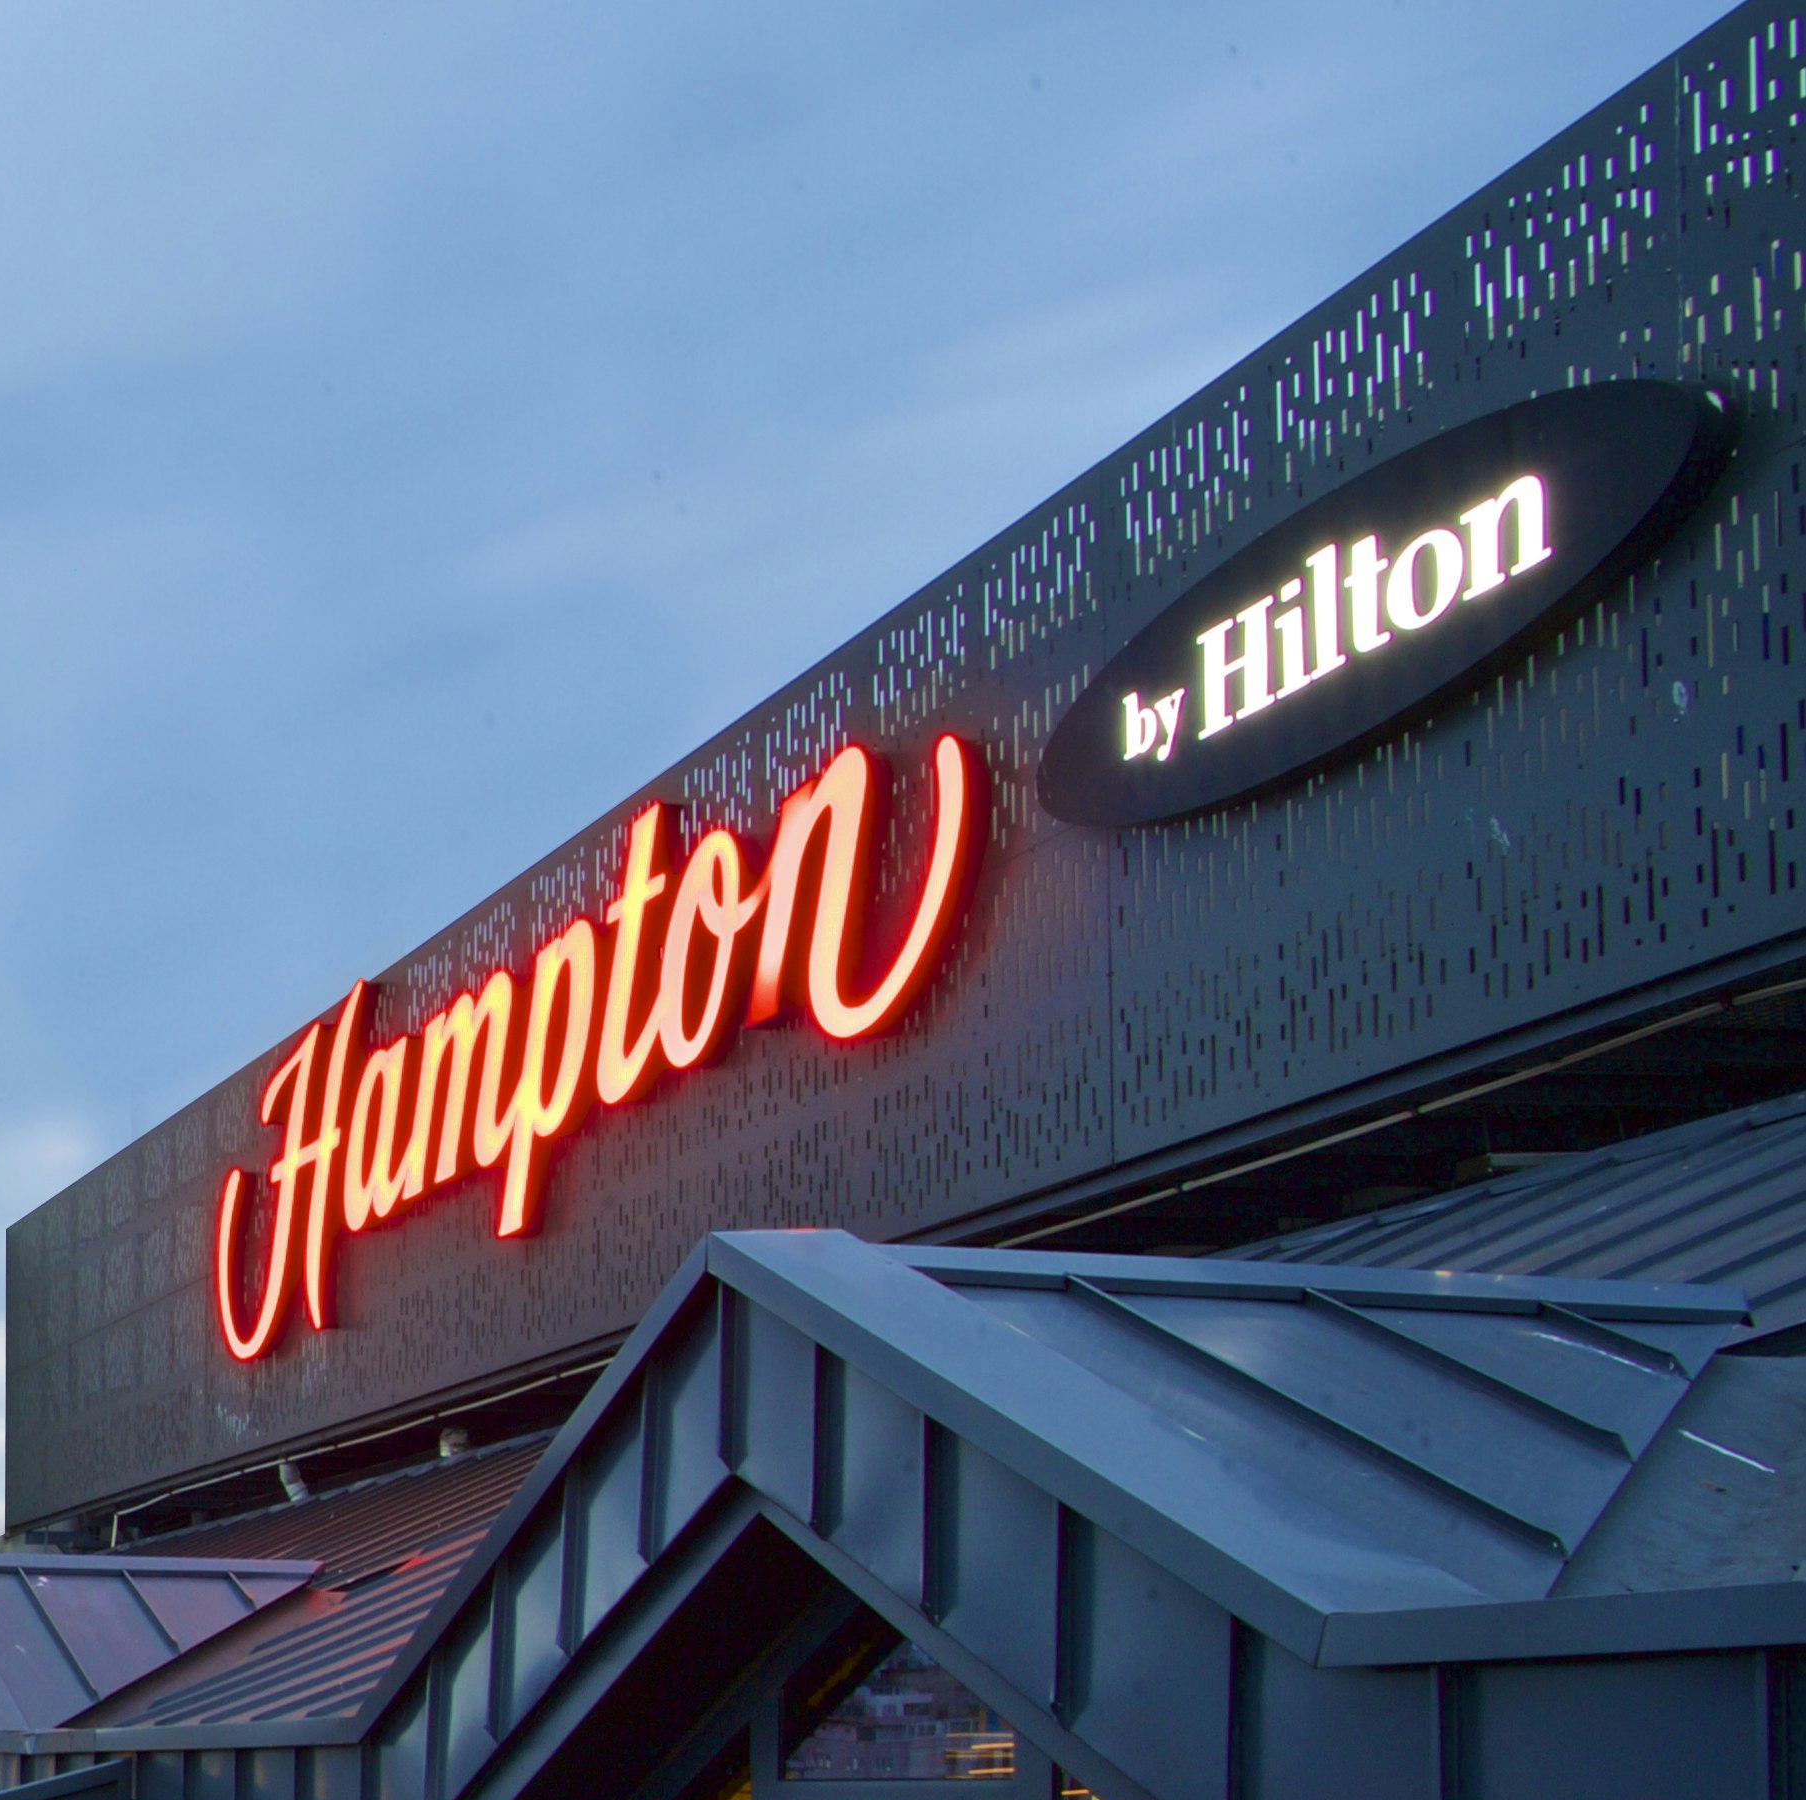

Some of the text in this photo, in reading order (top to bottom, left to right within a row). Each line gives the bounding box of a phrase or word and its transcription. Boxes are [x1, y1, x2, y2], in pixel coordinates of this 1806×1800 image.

[1122, 473, 1554, 762] by Hilton
[217, 734, 969, 1360] Hampton
